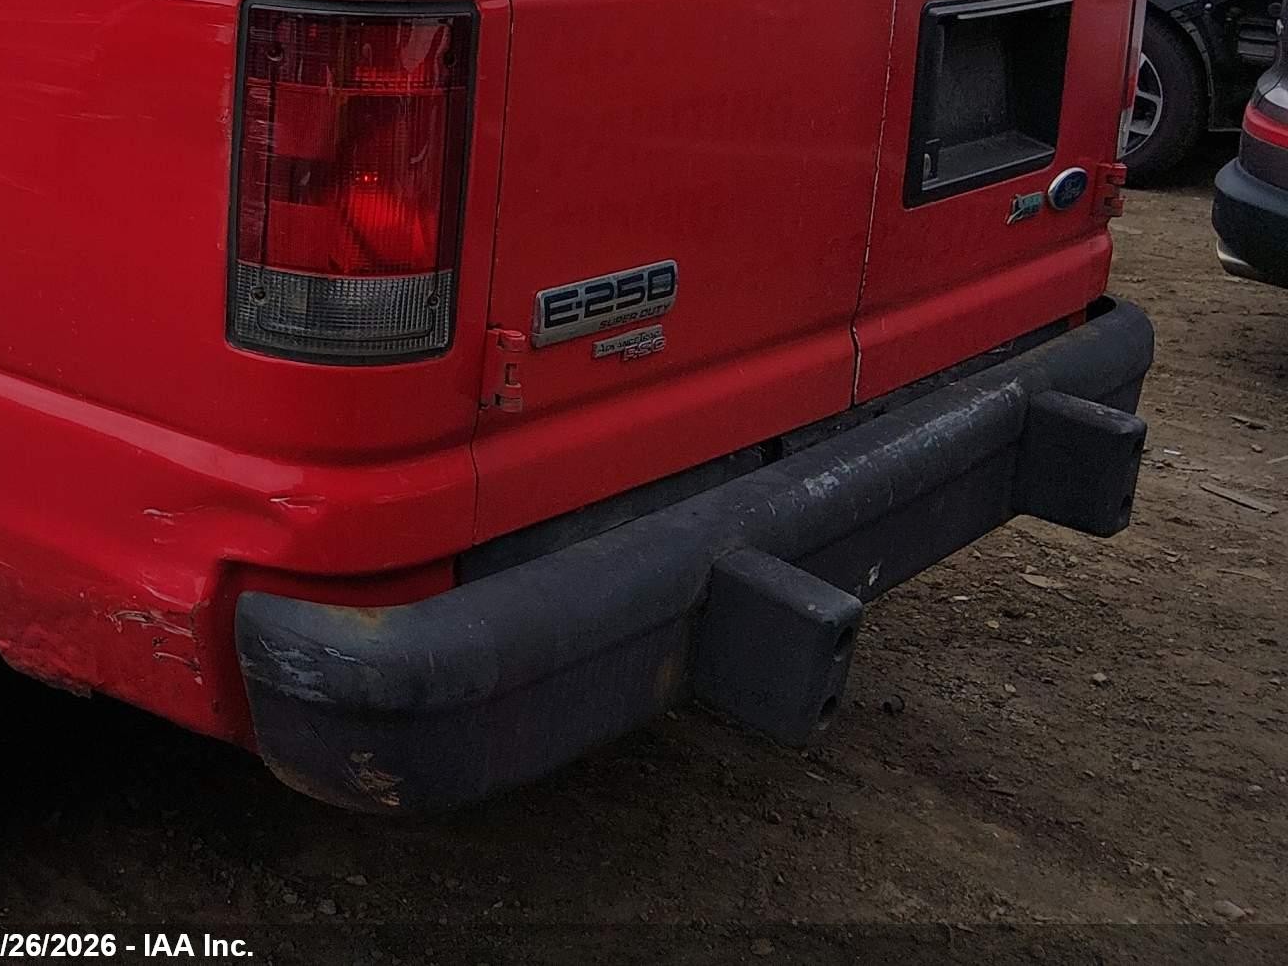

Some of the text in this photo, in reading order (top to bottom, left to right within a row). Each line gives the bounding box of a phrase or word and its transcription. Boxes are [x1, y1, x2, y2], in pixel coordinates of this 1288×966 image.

[544, 265, 676, 329] E-250
[599, 303, 671, 330] SUPER DUTY
